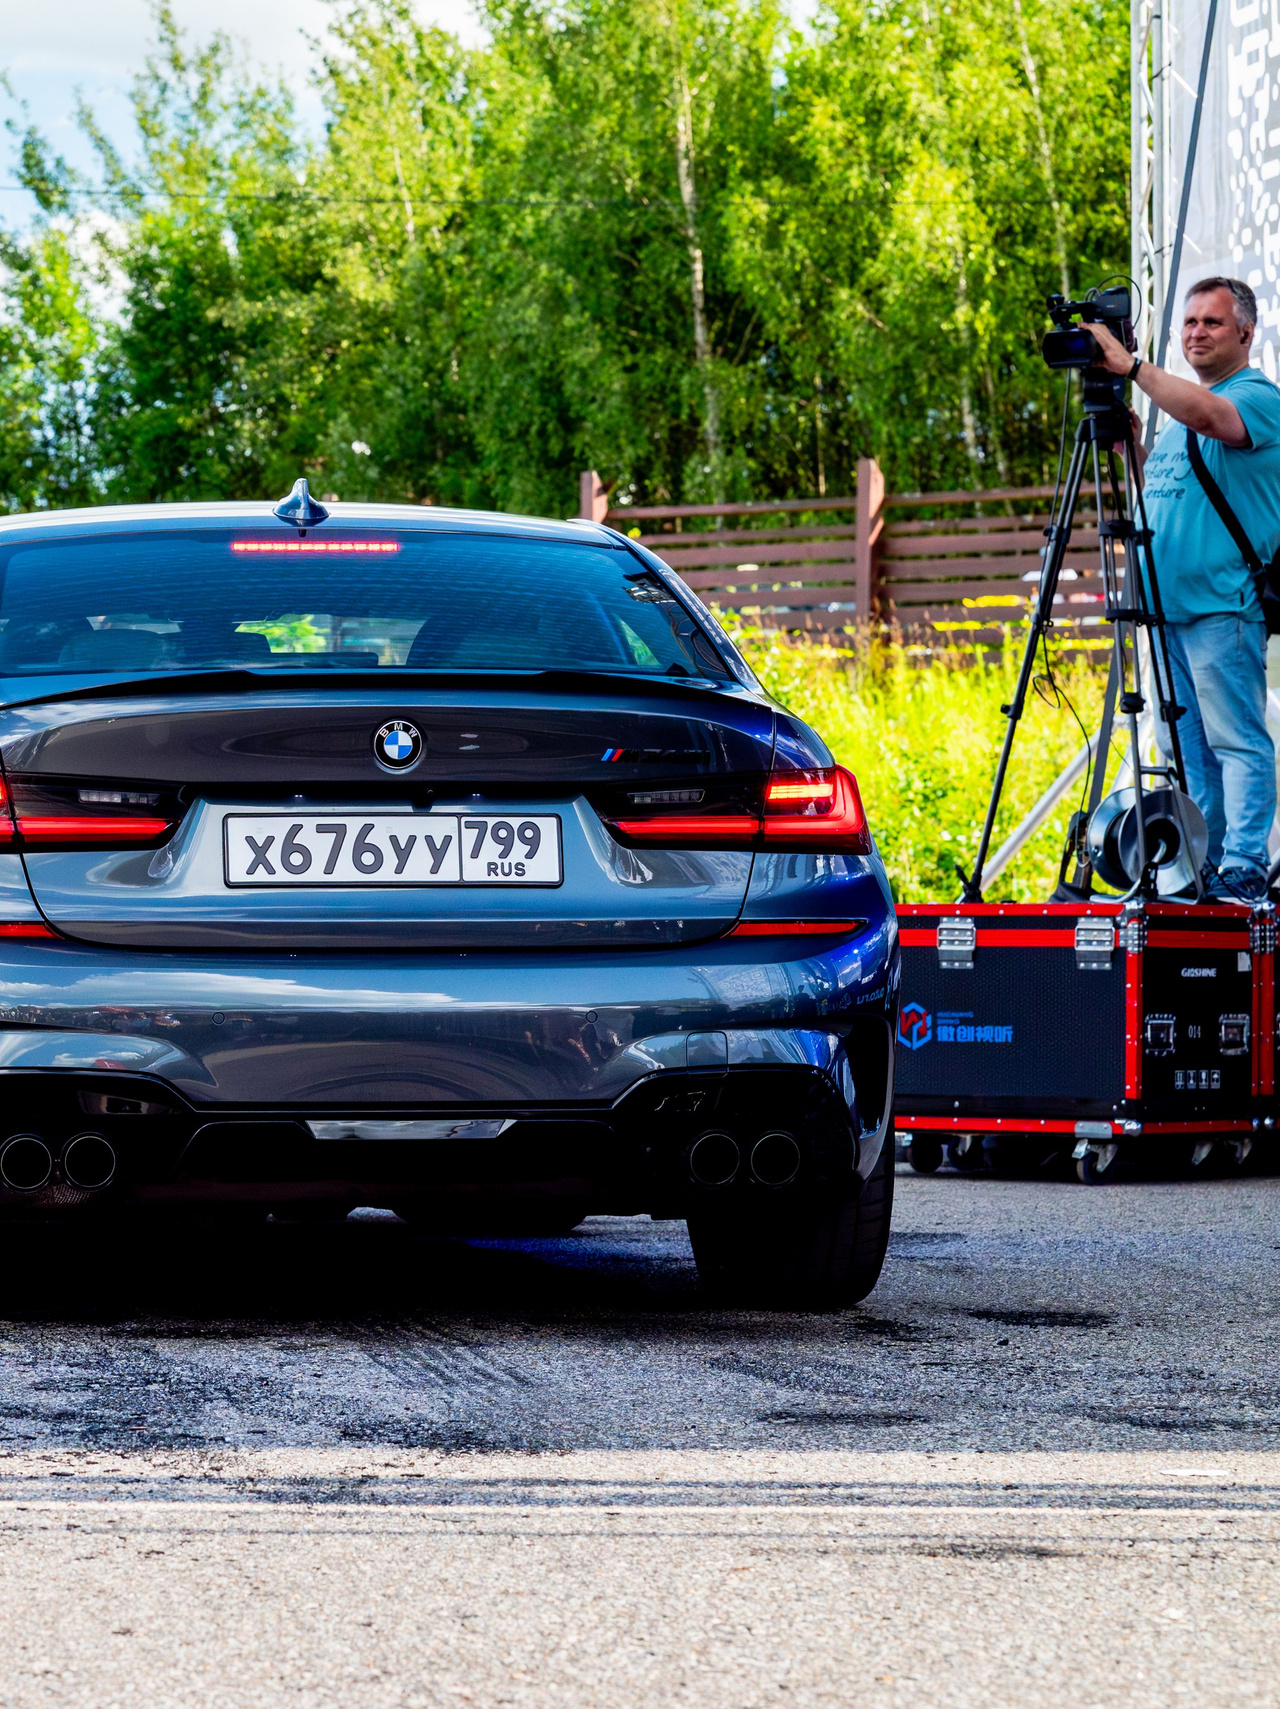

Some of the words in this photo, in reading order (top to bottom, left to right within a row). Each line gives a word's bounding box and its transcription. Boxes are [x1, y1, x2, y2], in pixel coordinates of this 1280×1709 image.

[380, 722, 418, 738] BMW
[464, 820, 542, 860] 799
[486, 861, 526, 877] RUS
